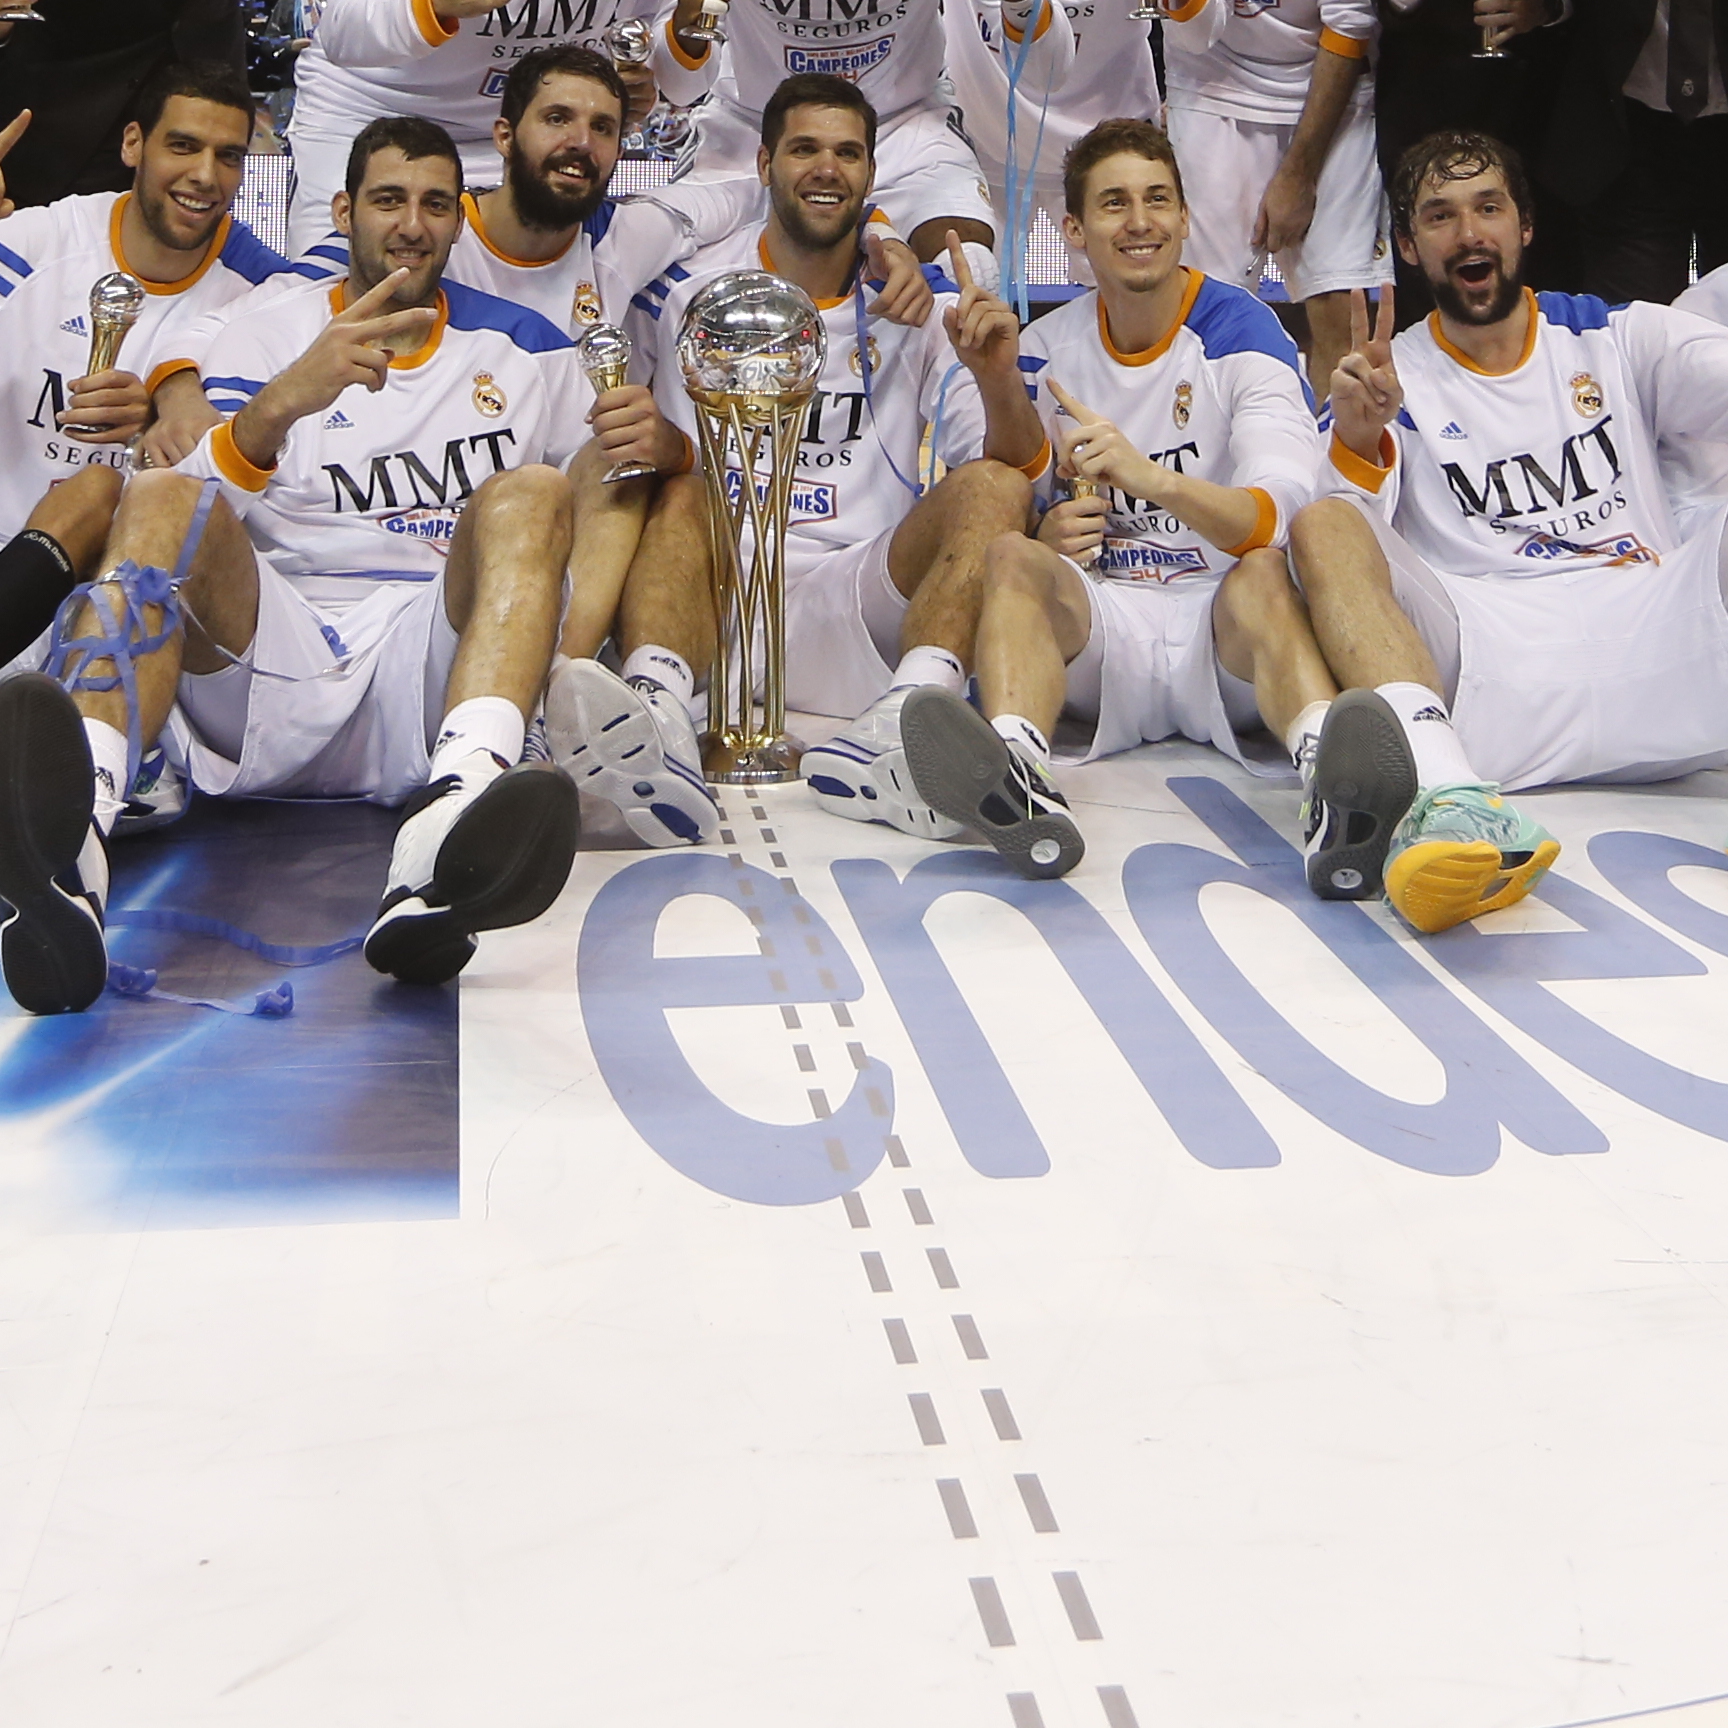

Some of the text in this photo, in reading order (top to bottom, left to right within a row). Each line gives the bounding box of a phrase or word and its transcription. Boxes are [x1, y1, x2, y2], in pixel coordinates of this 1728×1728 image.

[777, 4, 907, 39] SEGUROS
[790, 39, 890, 73] CAMPEONES
[59, 324, 89, 338] adidas
[321, 428, 516, 513] MMT
[1440, 414, 1622, 518] MMT
